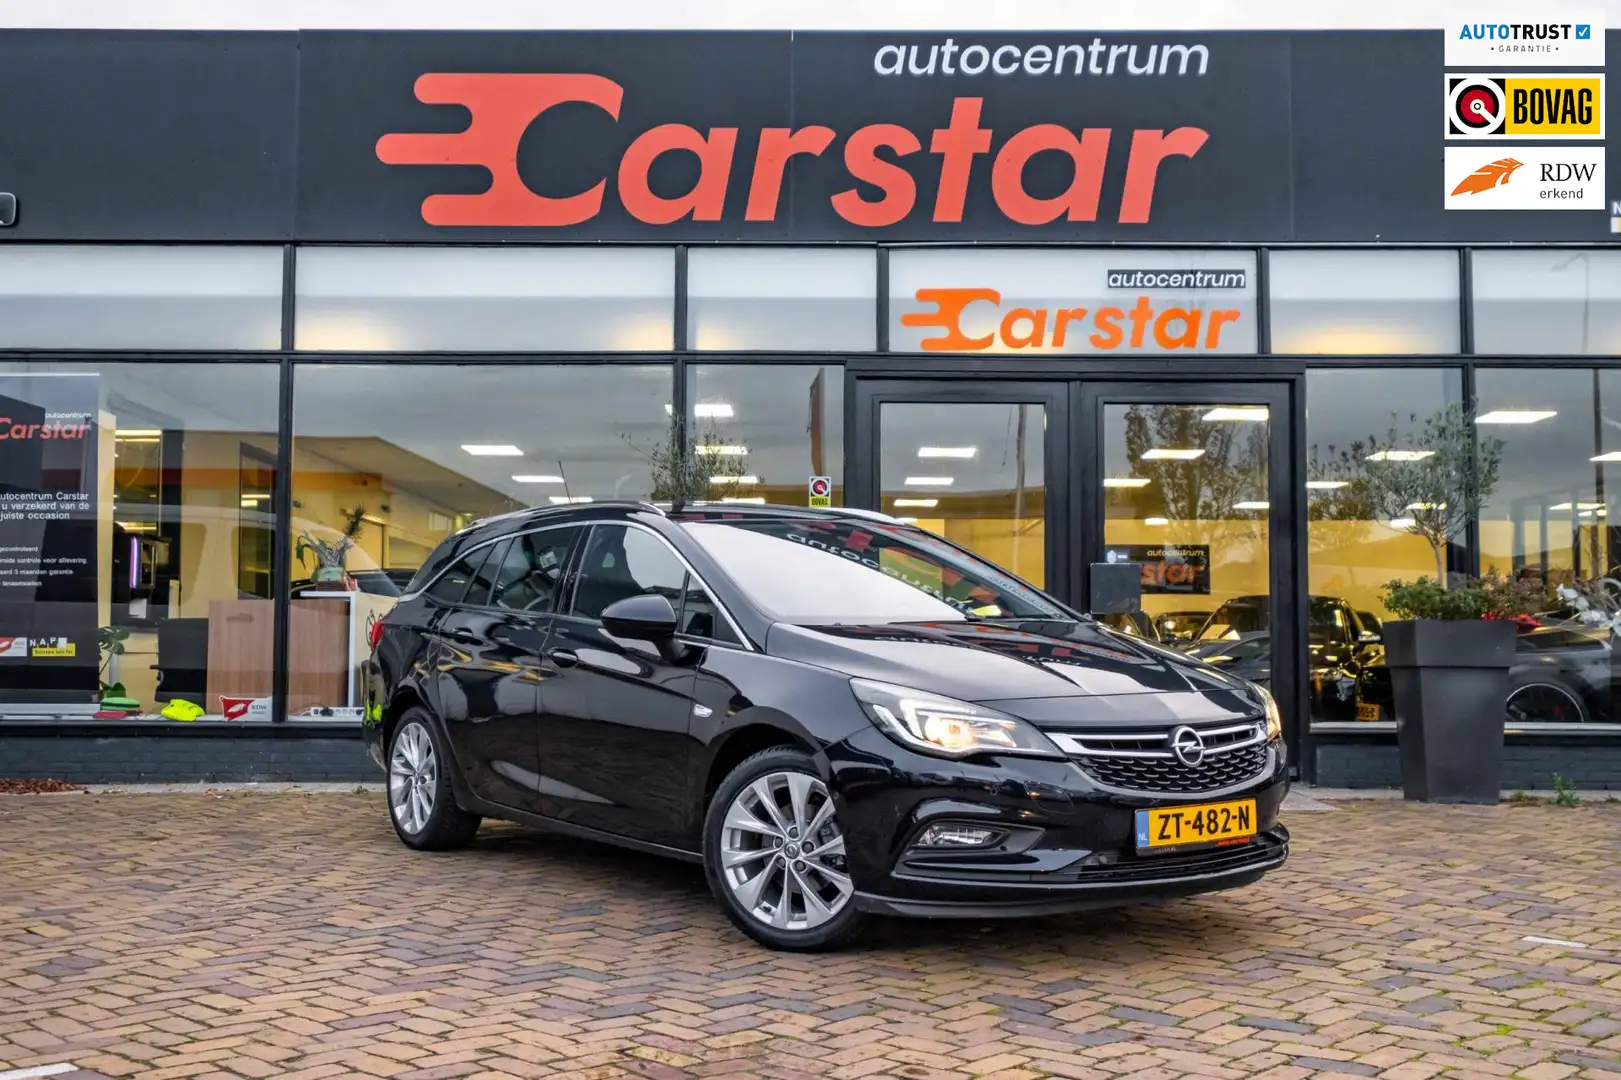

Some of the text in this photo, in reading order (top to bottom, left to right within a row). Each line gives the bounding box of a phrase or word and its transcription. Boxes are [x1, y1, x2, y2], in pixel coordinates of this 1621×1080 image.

[874, 38, 1210, 78] autocentrum
[375, 72, 1210, 228] Carstar
[1108, 270, 1246, 288] autocentrum
[901, 288, 1241, 351] Carstar
[11, 502, 57, 510] verzekerd
[78, 502, 90, 510] de
[56, 492, 89, 500] Carstar
[27, 512, 70, 520] occasion
[1138, 805, 1250, 841] NL ZT-482-N
